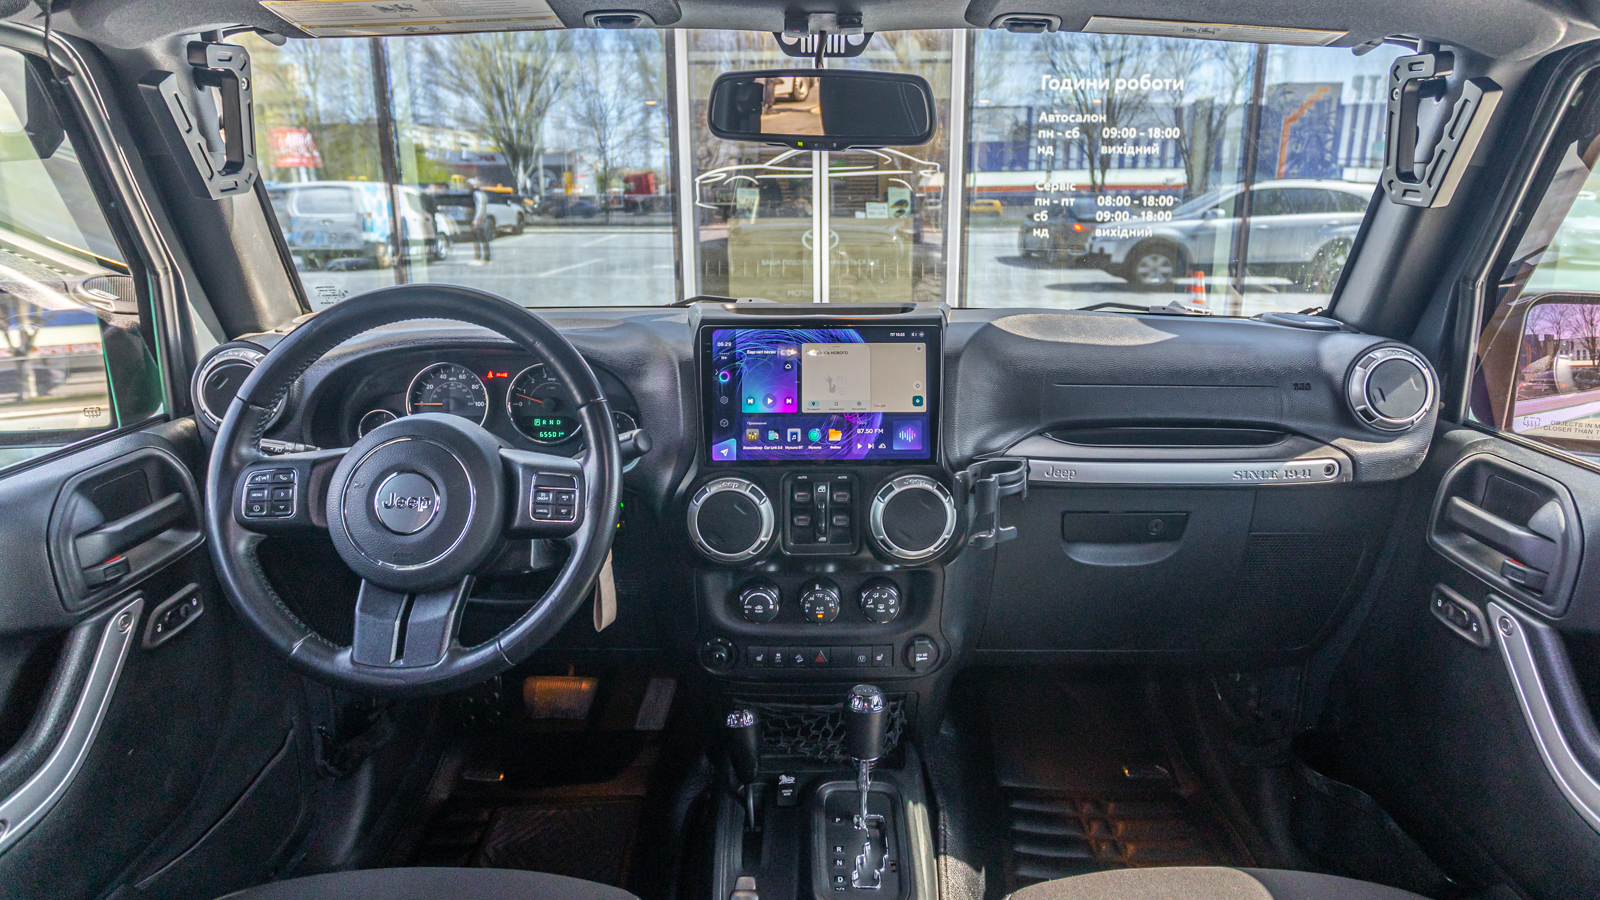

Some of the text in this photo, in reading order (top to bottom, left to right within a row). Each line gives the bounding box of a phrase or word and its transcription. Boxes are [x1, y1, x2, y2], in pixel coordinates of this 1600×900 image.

[1041, 73, 1184, 94] Години роботи
[1038, 111, 1107, 123] Автосалон
[1038, 129, 1054, 138] пн
[1065, 127, 1080, 139] сб
[1102, 127, 1137, 139] 09:00
[1148, 127, 1181, 139] 18:00
[1037, 143, 1160, 156] нд вихідний
[1035, 181, 1076, 194] Сервіс
[1034, 197, 1050, 206] пн
[1060, 197, 1075, 206] пт
[1096, 195, 1131, 207] 08:00
[1142, 195, 1174, 207] 18:00
[1033, 210, 1048, 222] сб
[1095, 210, 1130, 222] 09:00
[1140, 210, 1173, 222] 18:00
[1032, 226, 1153, 239] нд вихідний
[1543, 425, 1572, 433] CLOSER
[1574, 427, 1593, 435] THAN
[1551, 420, 1583, 428] OBJECTS
[1044, 465, 1077, 480] Jeep
[1232, 469, 1279, 480] SINCE
[382, 492, 432, 512] Jeep
